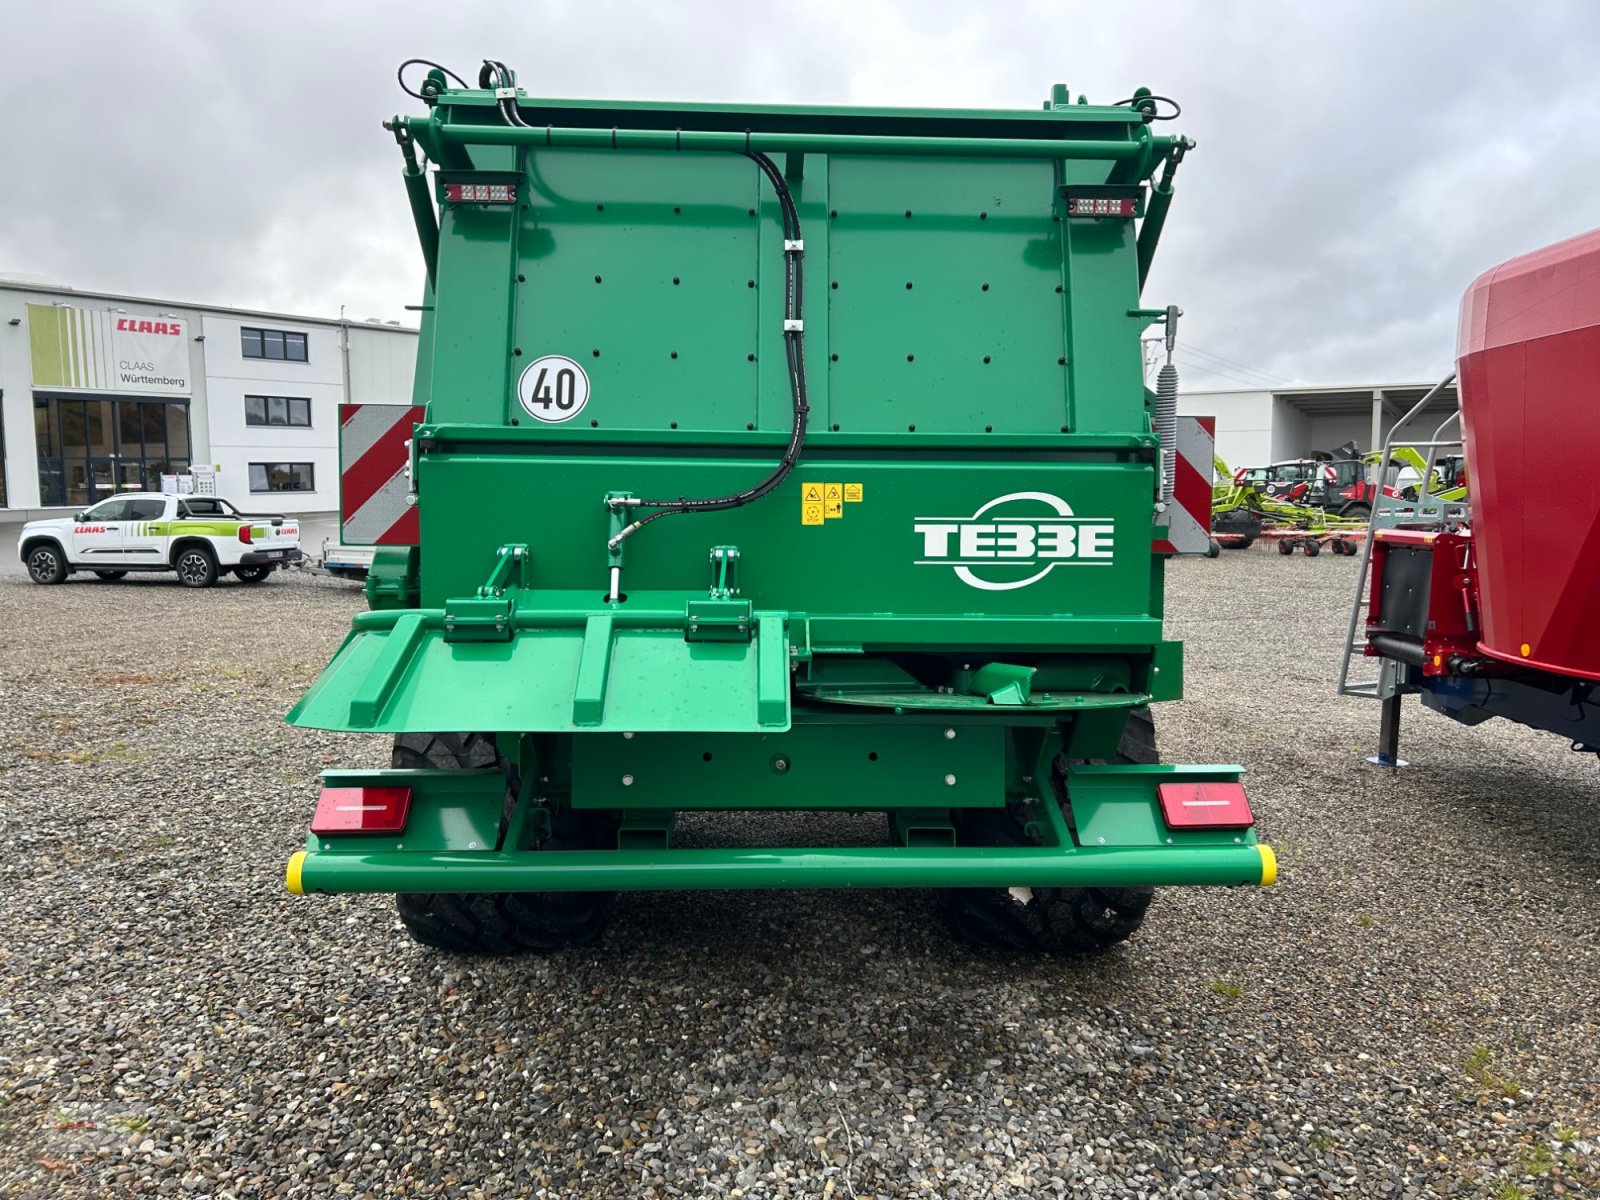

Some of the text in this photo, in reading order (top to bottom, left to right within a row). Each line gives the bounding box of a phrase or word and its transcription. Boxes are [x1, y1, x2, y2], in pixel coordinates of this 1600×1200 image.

[117, 318, 181, 336] CLAAS
[119, 360, 154, 371] CLAAS
[120, 373, 185, 387] Württemberg
[531, 367, 576, 411] 40
[74, 526, 106, 534] CLAAS
[914, 523, 1115, 558] TEBBE
